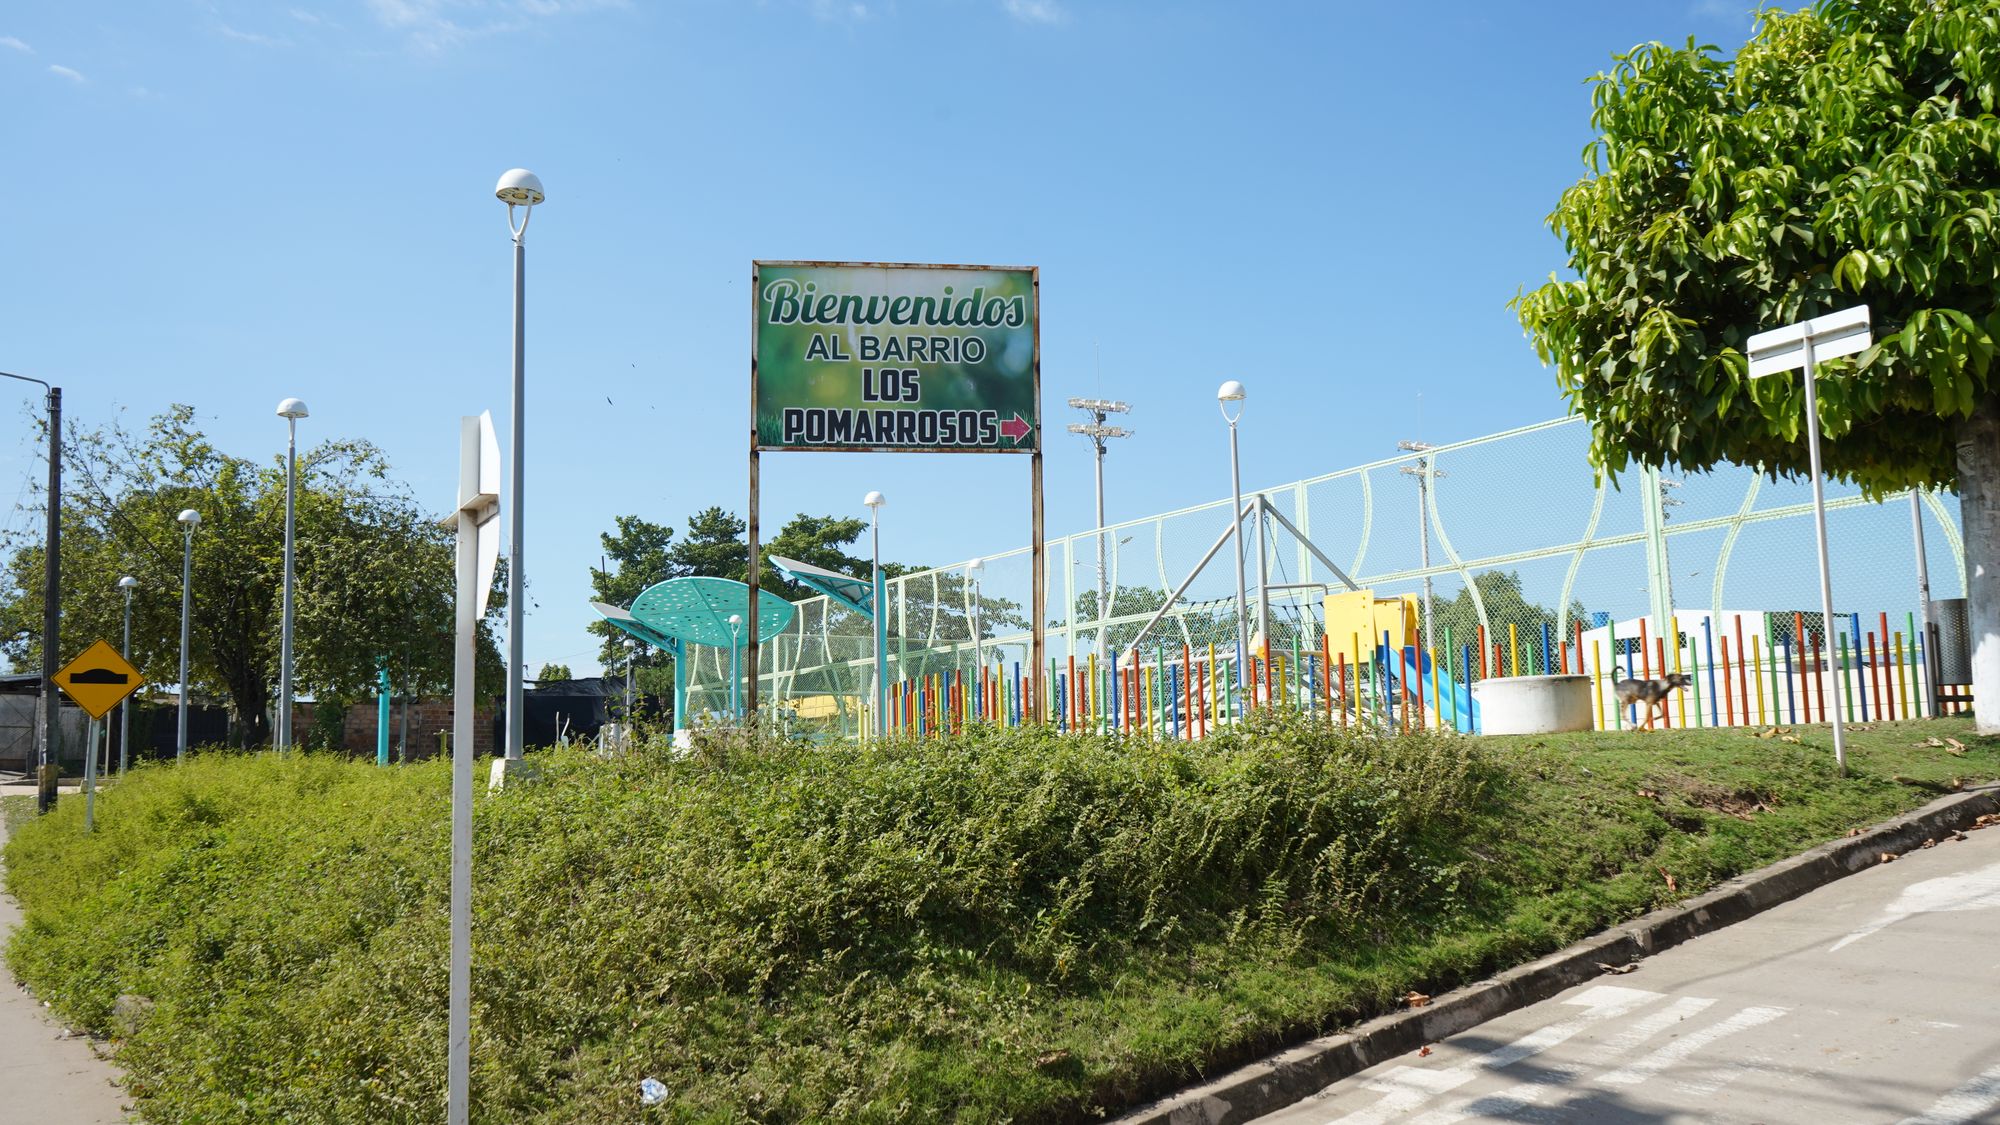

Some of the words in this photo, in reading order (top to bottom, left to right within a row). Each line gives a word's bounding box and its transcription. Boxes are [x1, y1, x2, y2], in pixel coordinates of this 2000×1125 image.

[765, 279, 1025, 327] Bienvenidos
[806, 334, 849, 361] AL
[859, 336, 985, 363] BARRIO
[862, 369, 919, 402] LOS
[784, 409, 997, 443] POMARROSOS
